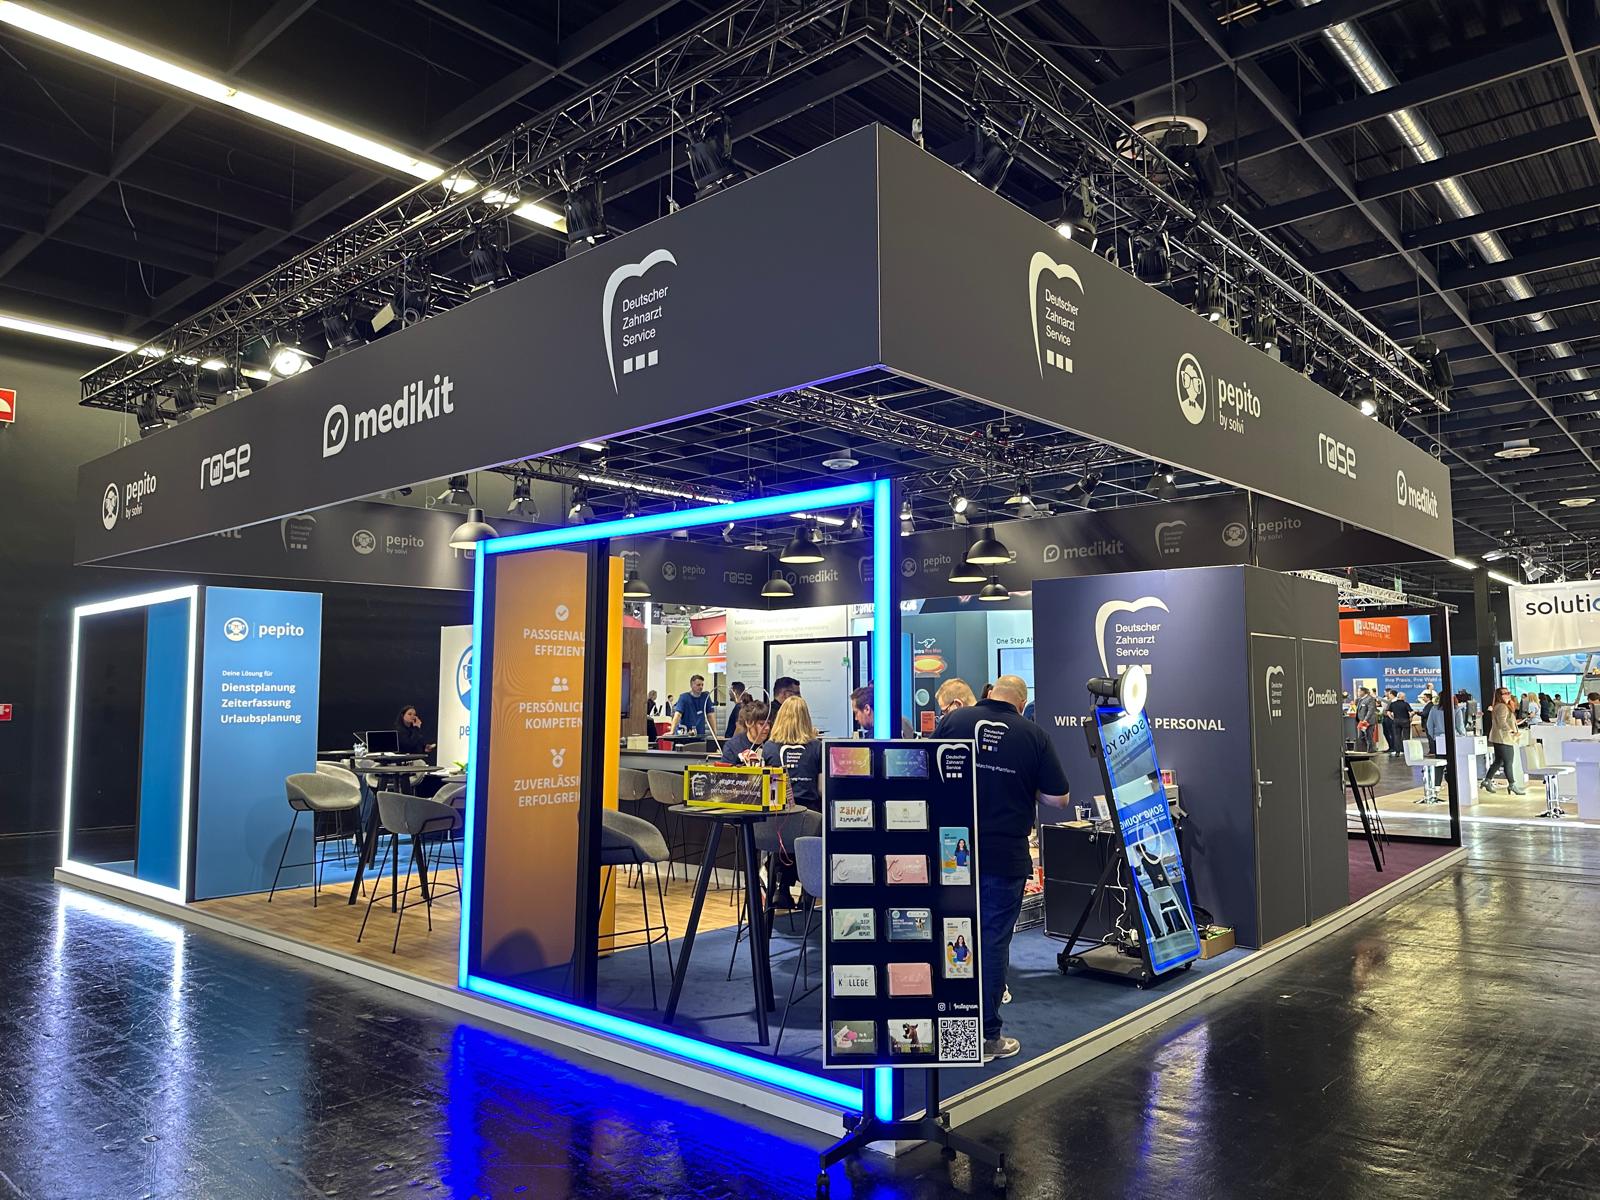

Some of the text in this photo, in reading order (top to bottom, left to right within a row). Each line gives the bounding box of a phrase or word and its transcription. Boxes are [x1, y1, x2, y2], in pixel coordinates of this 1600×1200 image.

[623, 285, 669, 313] Deutscher
[1045, 289, 1079, 316] Deutscher
[623, 306, 662, 330] Zahnarzt
[1045, 307, 1075, 332] Zahnarzt
[623, 327, 656, 348] Service
[1046, 325, 1072, 347] Service
[1218, 378, 1261, 418] pepito
[355, 375, 454, 442] medikit
[1219, 411, 1244, 434] by solvi
[1319, 432, 1357, 480] rose
[200, 443, 251, 490] rose
[126, 472, 157, 505] pepito
[1408, 486, 1439, 519] medikit
[125, 507, 132, 520] by
[1257, 517, 1301, 534] pepito
[386, 534, 425, 551] pepito
[1064, 540, 1124, 559] medikit
[923, 554, 951, 568] pepito
[682, 564, 706, 577] pepito
[723, 571, 753, 585] rose
[799, 569, 839, 584] medikit
[258, 622, 304, 639] pepito
[1115, 623, 1161, 632] Deutscher
[1116, 635, 1155, 645] Zahnarzt
[1116, 647, 1149, 657] Service
[241, 670, 264, 678] Lösung
[1385, 667, 1397, 675] Fit
[222, 683, 296, 694] Dienstplanung
[222, 699, 291, 709] Zeiterfassung
[1315, 689, 1338, 705] medikit
[220, 714, 301, 725] Urlaubsplanung
[1054, 715, 1078, 727] WIR
[1155, 717, 1226, 731] PERSONAL
[514, 774, 580, 791] ZUVERLÄSSI
[518, 791, 578, 807] ERFOLGREI
[953, 1002, 979, 1011] Instagram
